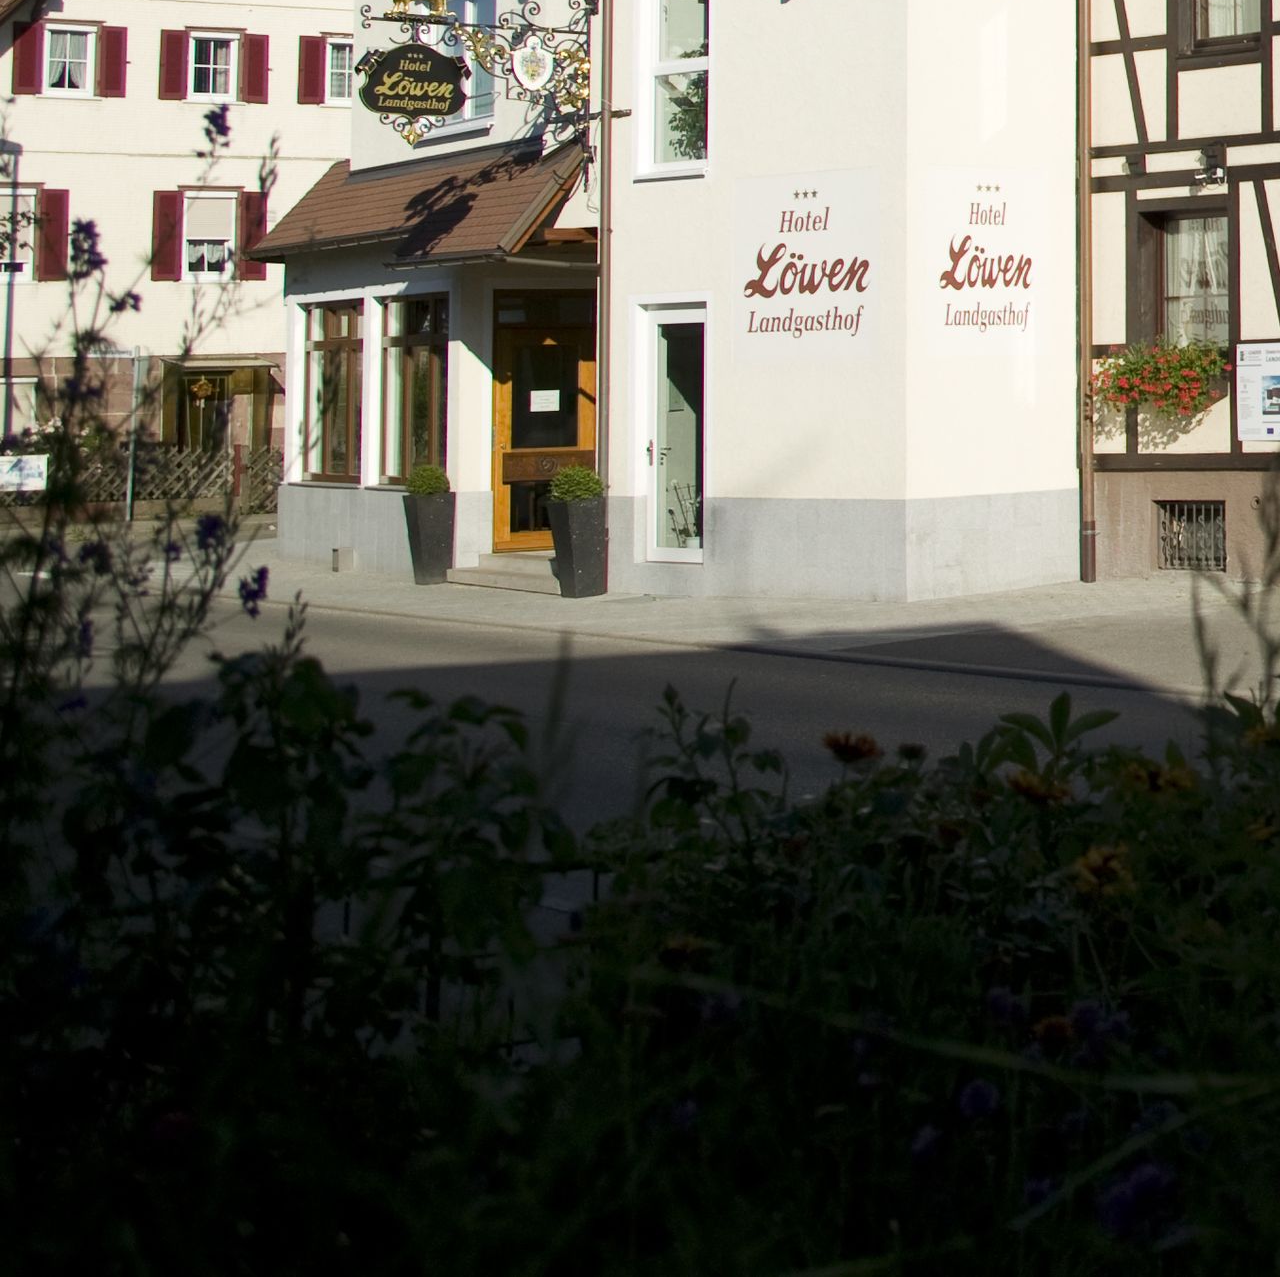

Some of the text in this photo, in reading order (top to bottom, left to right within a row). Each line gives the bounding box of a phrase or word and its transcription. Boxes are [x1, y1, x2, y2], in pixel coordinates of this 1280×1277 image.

[399, 59, 432, 72] Hotel
[374, 71, 454, 98] Löwen
[378, 96, 451, 112] Landgasthof
[779, 206, 830, 233] Hotel
[969, 202, 1006, 225] Hotel
[744, 243, 871, 298] Löwen
[940, 234, 1033, 290] Löwen
[747, 305, 864, 339] Landgasthof
[944, 302, 1030, 333] Landgasthof
